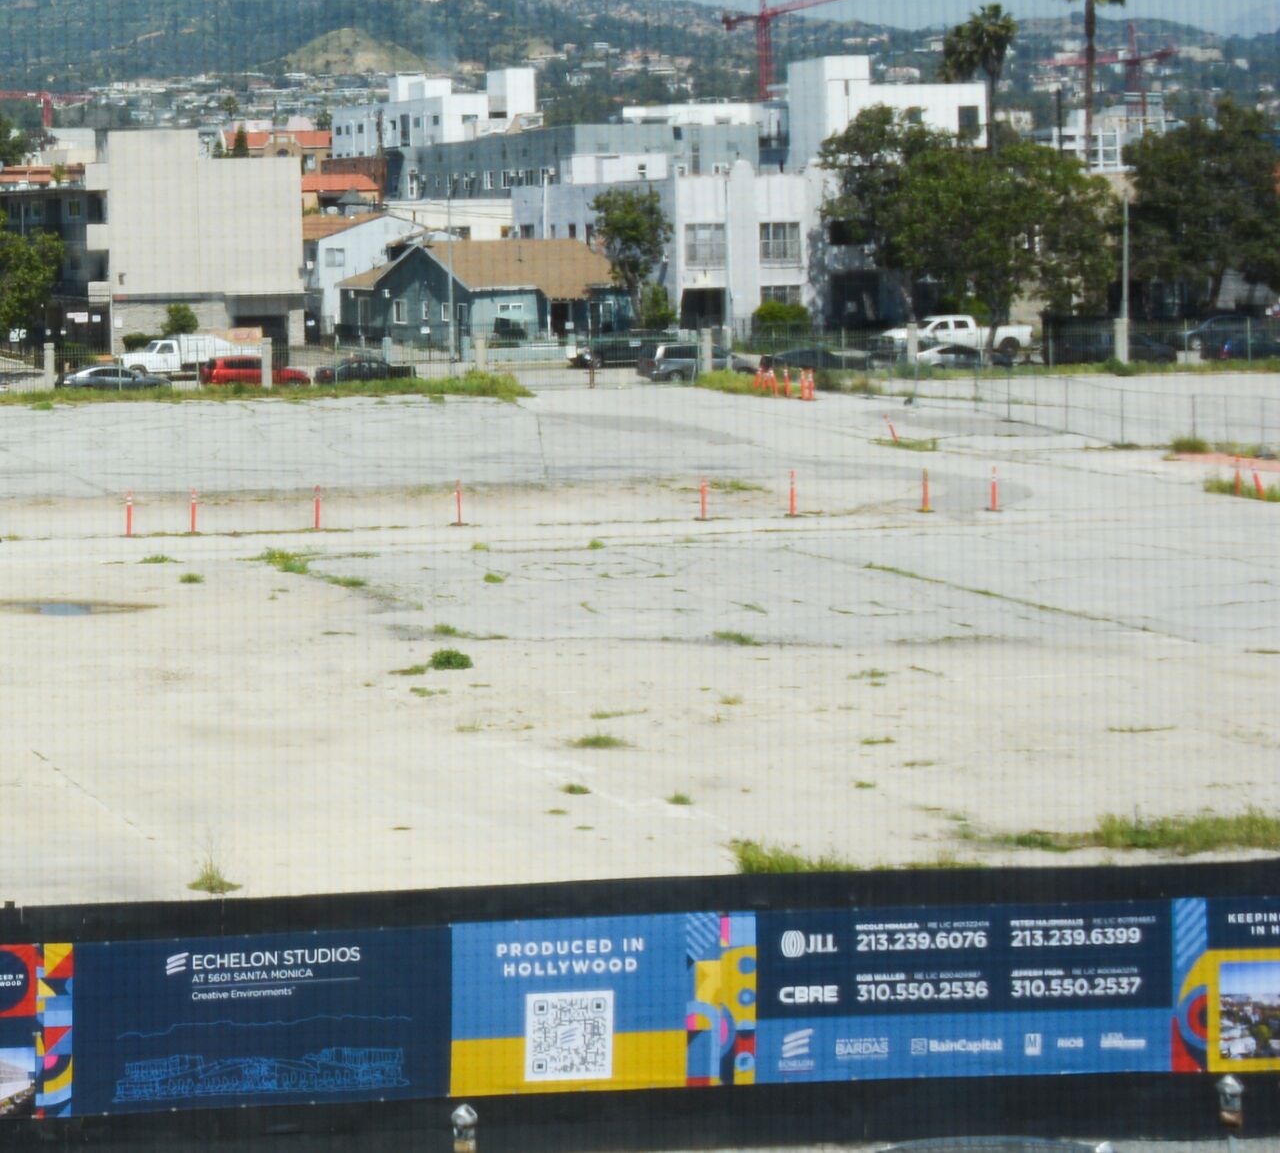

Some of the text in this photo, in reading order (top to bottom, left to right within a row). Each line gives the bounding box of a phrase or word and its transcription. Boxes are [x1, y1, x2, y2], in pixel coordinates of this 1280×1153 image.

[1228, 912, 1280, 923] KEEPIN
[1011, 927, 1141, 947] 213.239.6399
[1251, 925, 1265, 935] IN
[496, 938, 644, 957] PRODUCED IN
[806, 934, 838, 953] JLL
[856, 932, 988, 951] 213.239.6076
[193, 946, 361, 970] ECHELON STUDIOS
[192, 969, 313, 983] AT 5601 SANTA MONICA
[503, 959, 638, 977] HOLLYWOOD
[192, 987, 292, 1000] Creative Environments
[779, 985, 838, 1003] CBRE
[856, 981, 989, 1001] 310.550.2536
[1011, 977, 1141, 997] 310.550.2537
[836, 1042, 888, 1054] BARDAS
